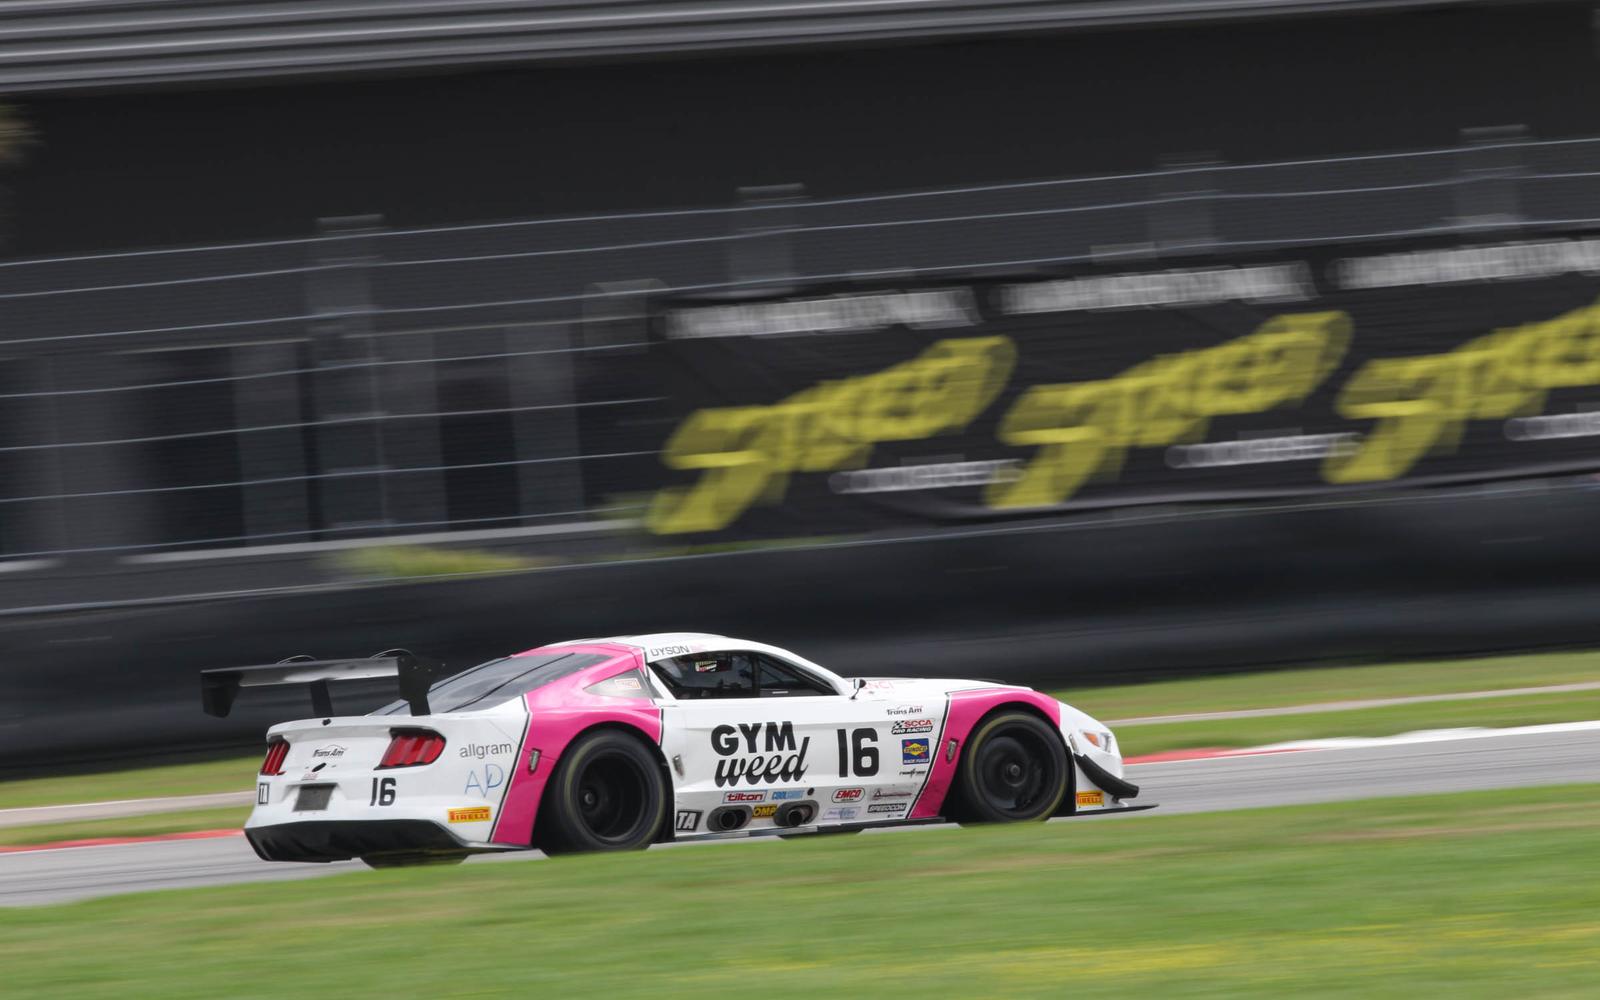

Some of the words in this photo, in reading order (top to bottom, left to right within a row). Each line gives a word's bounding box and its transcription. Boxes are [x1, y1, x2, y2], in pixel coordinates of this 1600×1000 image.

[650, 645, 690, 657] DYSON
[887, 707, 907, 716] Trans
[909, 705, 922, 714] Am
[904, 719, 932, 728] SCCA
[711, 721, 797, 755] GYM
[459, 743, 513, 760] allgram
[837, 727, 880, 778] 16
[714, 736, 810, 788] weed
[369, 777, 396, 807] 16
[726, 791, 764, 802] tilton
[835, 789, 862, 798] EMCO
[449, 809, 489, 820] PIRELLI
[752, 806, 777, 817] OMP
[676, 811, 697, 829] TA
